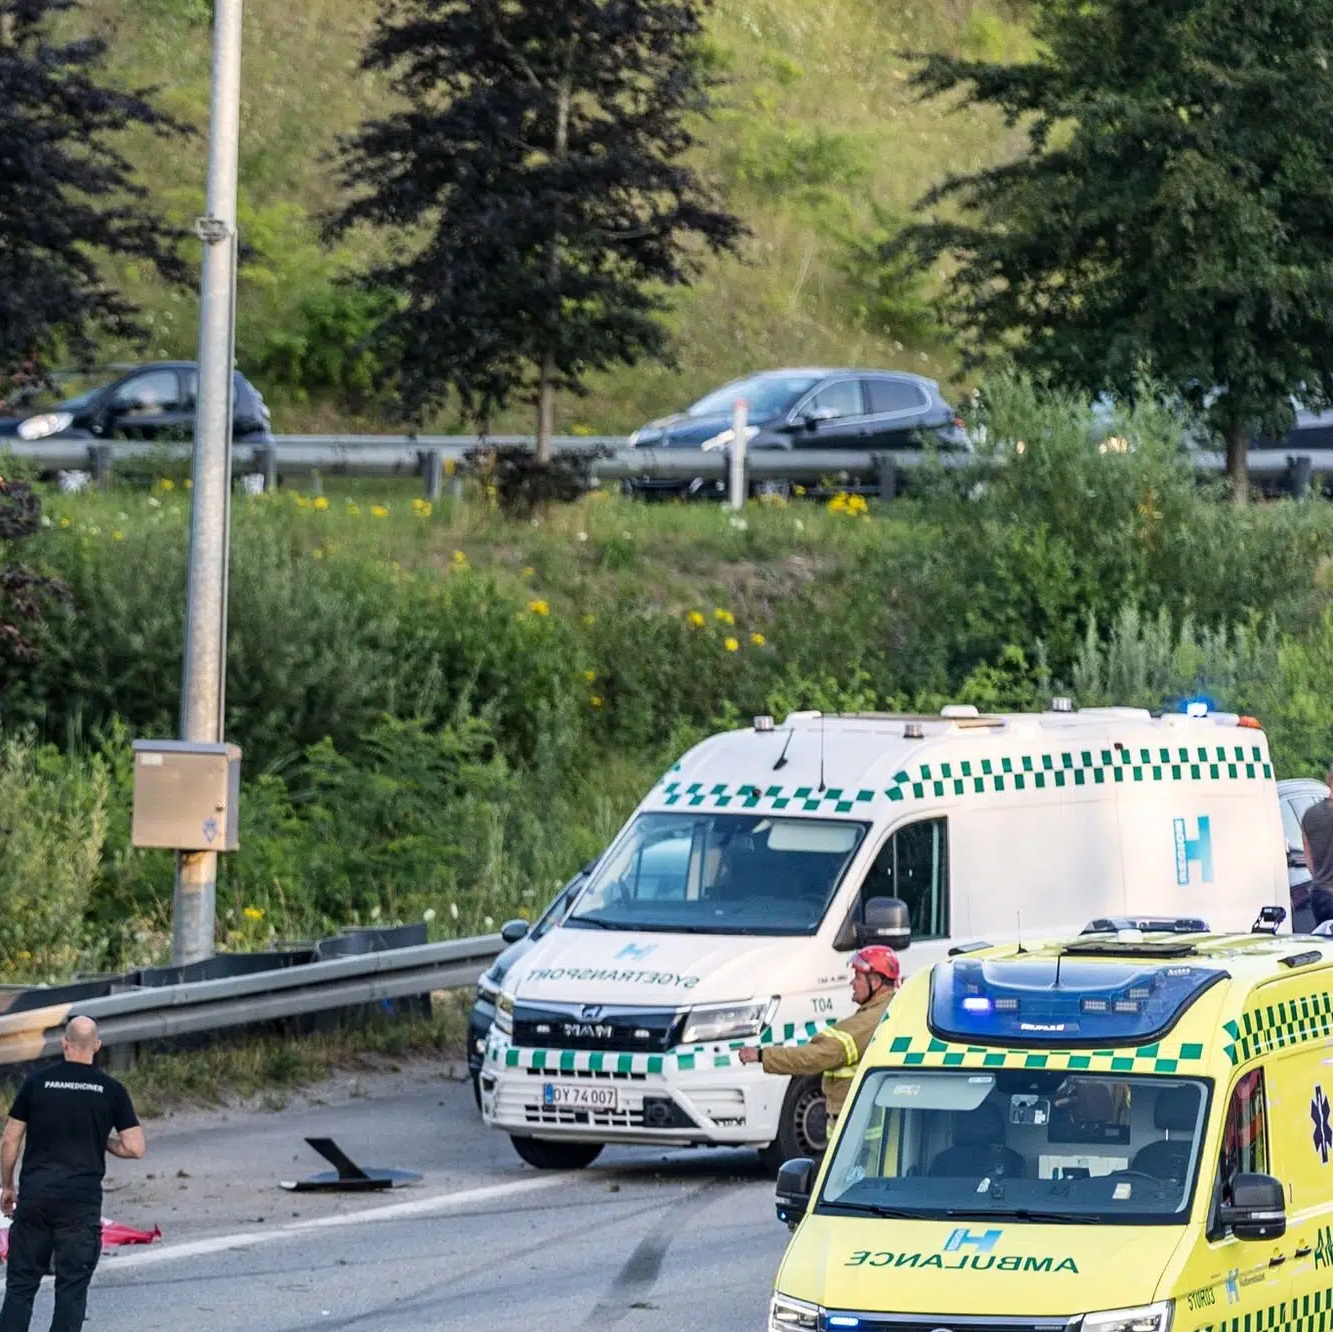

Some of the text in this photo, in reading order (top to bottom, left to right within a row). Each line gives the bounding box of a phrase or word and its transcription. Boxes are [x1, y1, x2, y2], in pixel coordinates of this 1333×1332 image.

[564, 1023, 612, 1038] MAN
[44, 1080, 104, 1093] PARAMEDICINER
[573, 1088, 589, 1103] 74
[590, 1090, 614, 1105] 007
